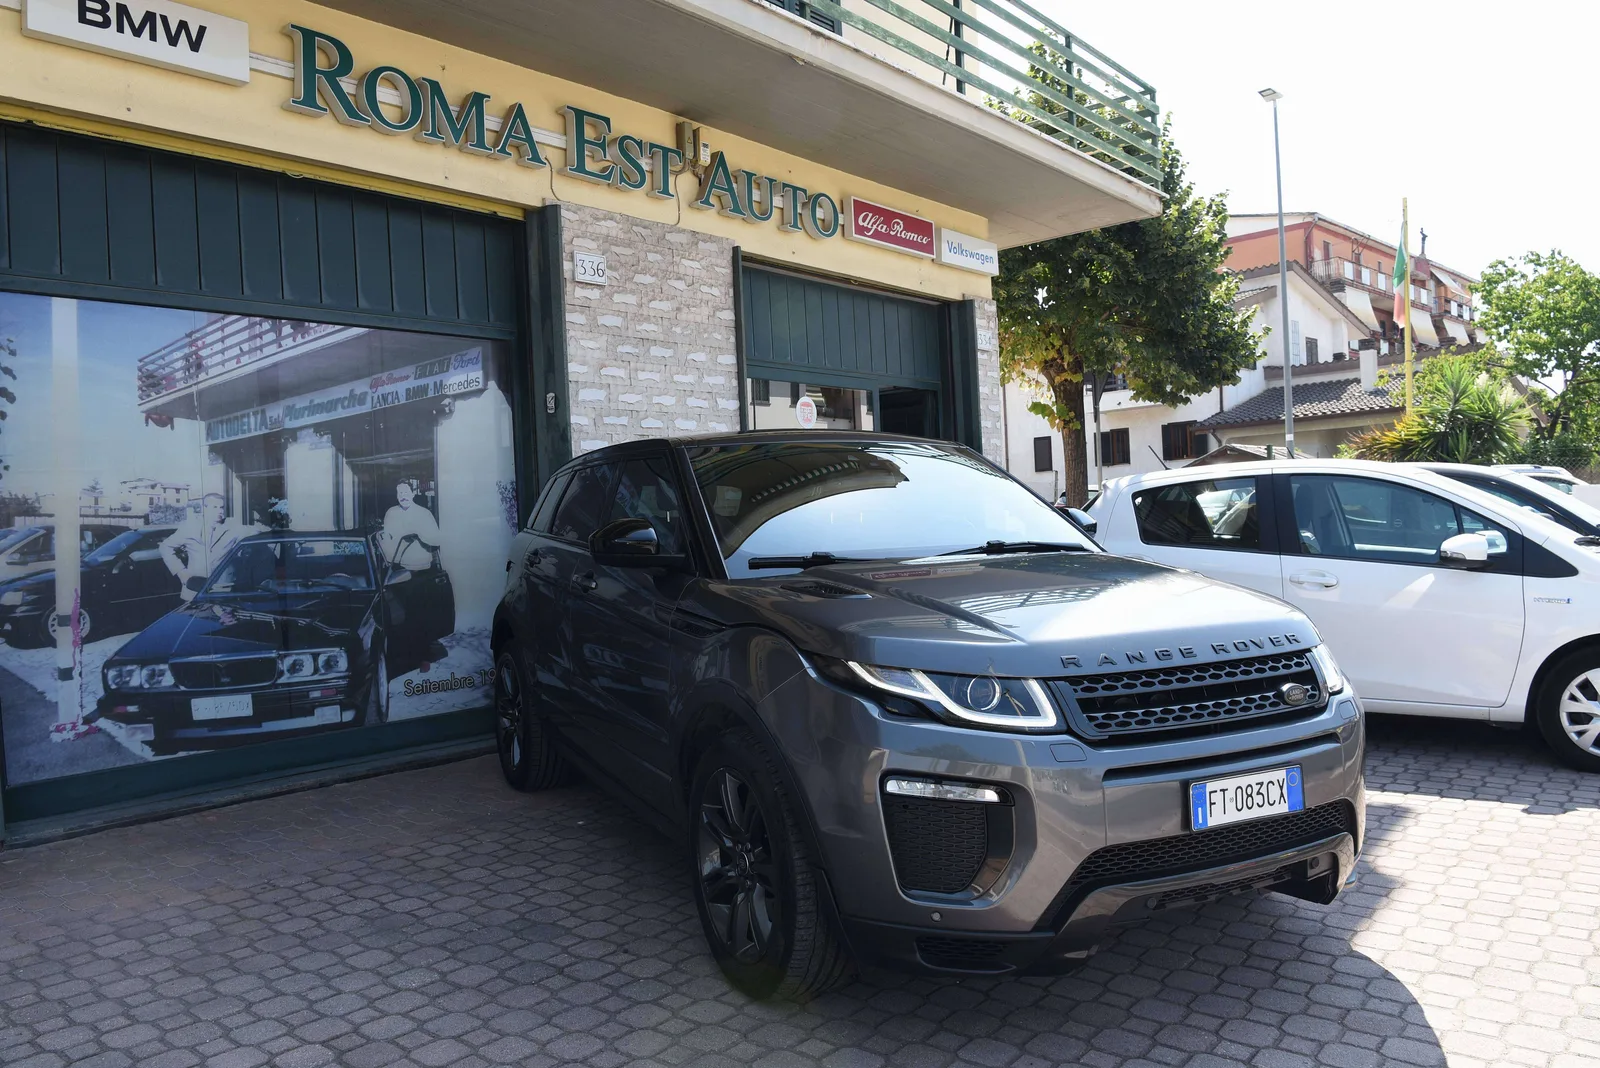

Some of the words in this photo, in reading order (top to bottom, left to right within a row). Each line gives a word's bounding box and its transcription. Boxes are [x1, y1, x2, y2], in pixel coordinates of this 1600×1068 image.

[78, 0, 207, 53] BMW
[286, 22, 548, 168] ROMA
[696, 149, 841, 240] AUTO
[857, 210, 889, 236] Alfa
[890, 218, 931, 245] Romeo
[578, 258, 605, 278] 336
[946, 239, 995, 265] Volkswagen
[415, 359, 449, 378] FIAT
[453, 350, 481, 371] Ford
[370, 389, 401, 409] LANCIA
[405, 382, 430, 402] BMW
[433, 372, 481, 395] Mercedes
[1060, 646, 1198, 669] RANGE
[1211, 632, 1302, 655] ROVER
[404, 671, 475, 697] Settembre
